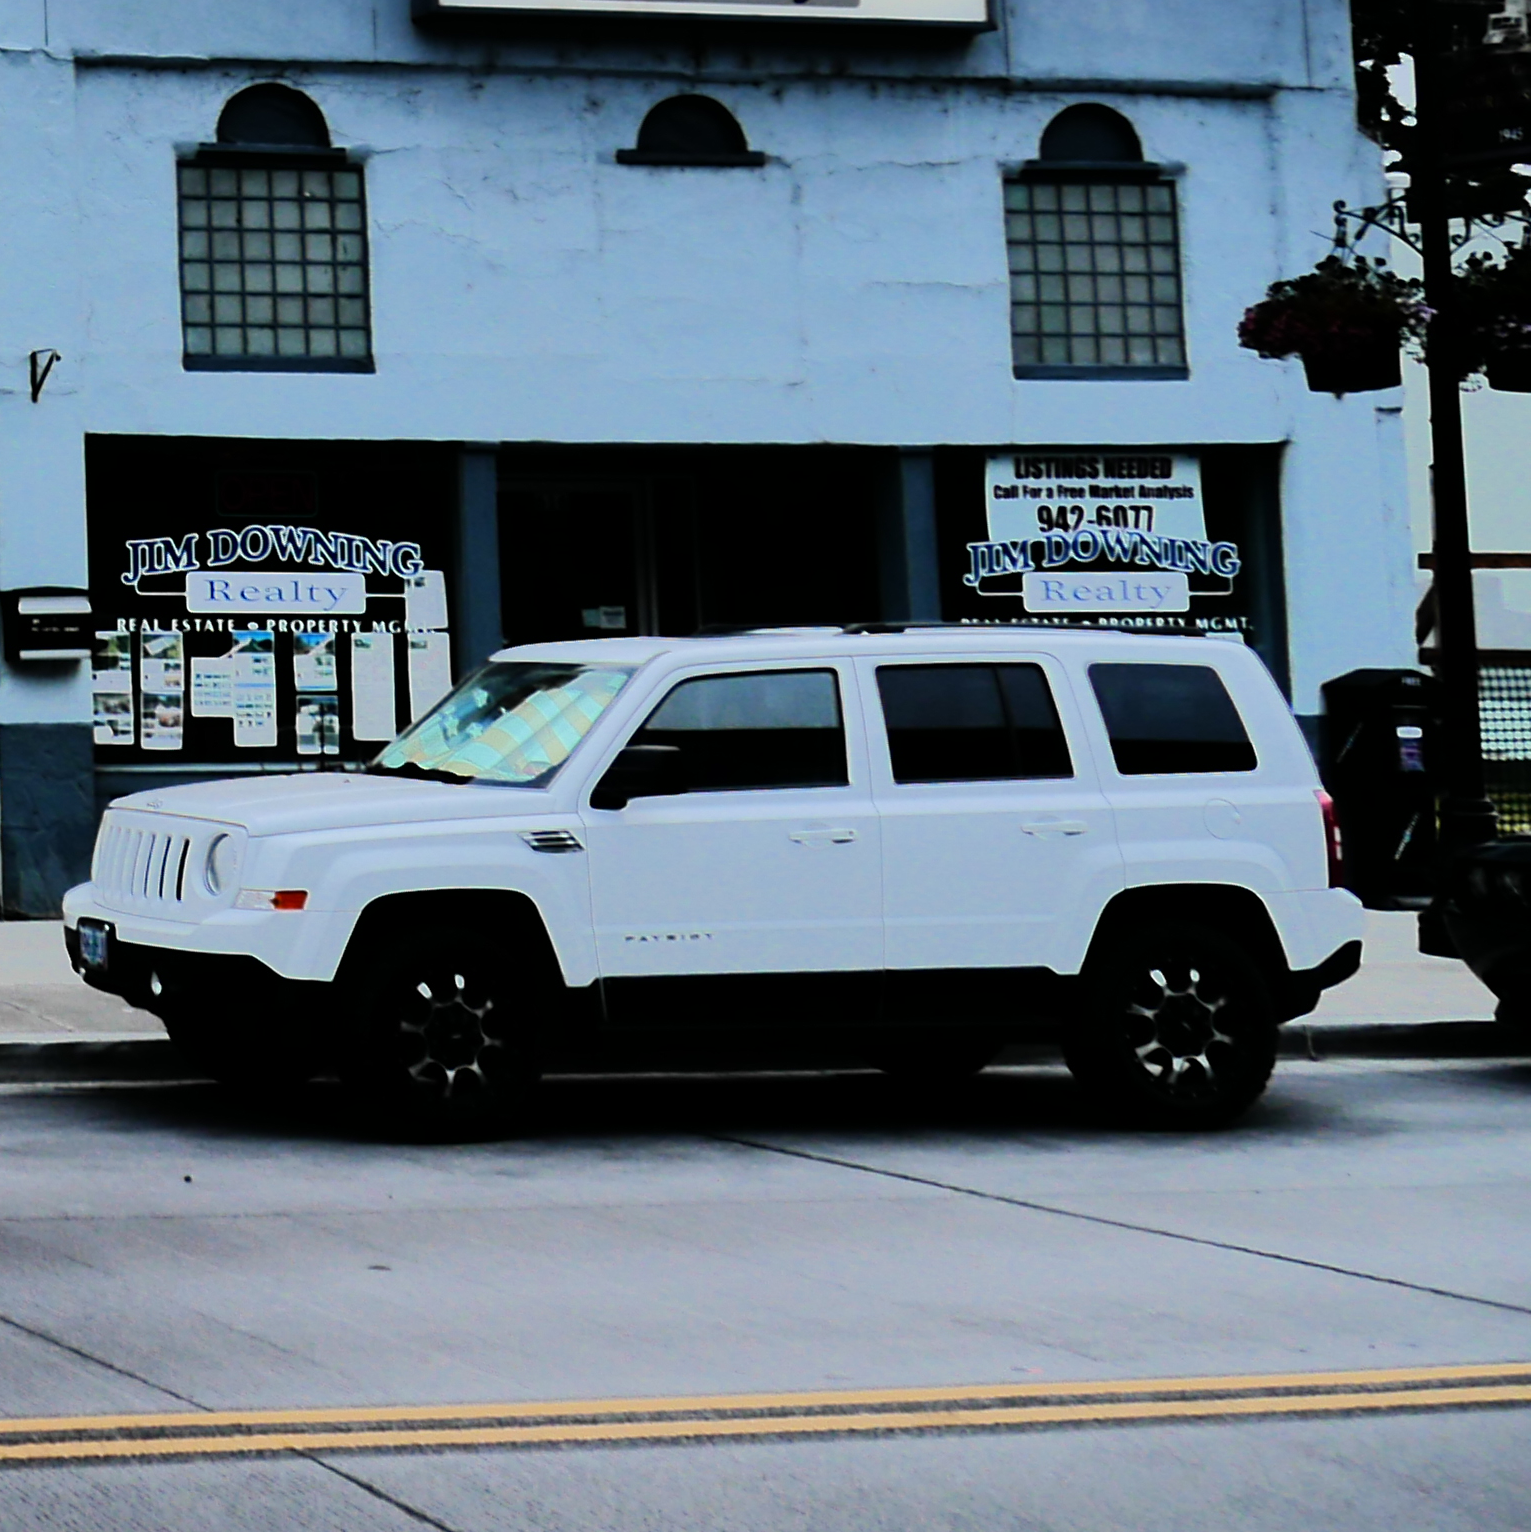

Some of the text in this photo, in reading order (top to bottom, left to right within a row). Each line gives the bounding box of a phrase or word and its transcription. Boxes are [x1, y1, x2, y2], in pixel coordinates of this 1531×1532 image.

[1013, 456, 1173, 479] LISTINGS NEEDED
[993, 484, 1194, 500] Call For a Free Market Analysis
[121, 524, 424, 585] JIM DOWNING
[962, 528, 1241, 586] JIM DOWNING
[204, 578, 349, 611] Realty
[1039, 578, 1173, 611] Realty
[117, 618, 163, 632] REAL
[171, 618, 236, 632] ESTATE
[266, 619, 361, 633] PROPERTY
